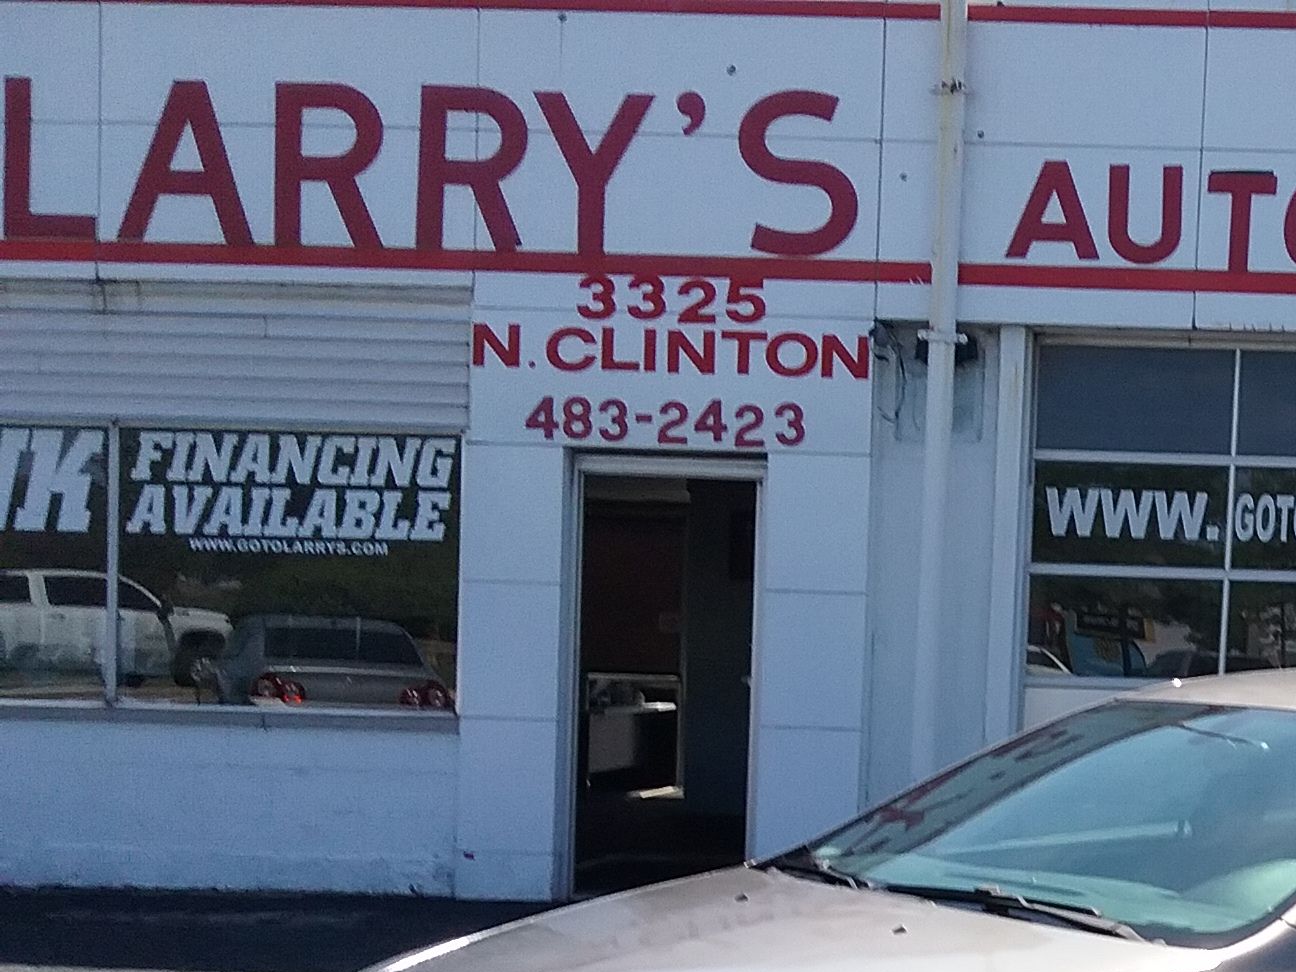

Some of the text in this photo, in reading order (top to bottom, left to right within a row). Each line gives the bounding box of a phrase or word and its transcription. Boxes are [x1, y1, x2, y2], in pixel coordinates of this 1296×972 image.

[576, 272, 767, 324] 3325
[525, 396, 806, 448] 483-2423
[131, 431, 456, 490] FINANCING
[126, 484, 452, 542] AVAILABLE
[189, 536, 389, 557] WWW.GOTOLARRYS.COM
